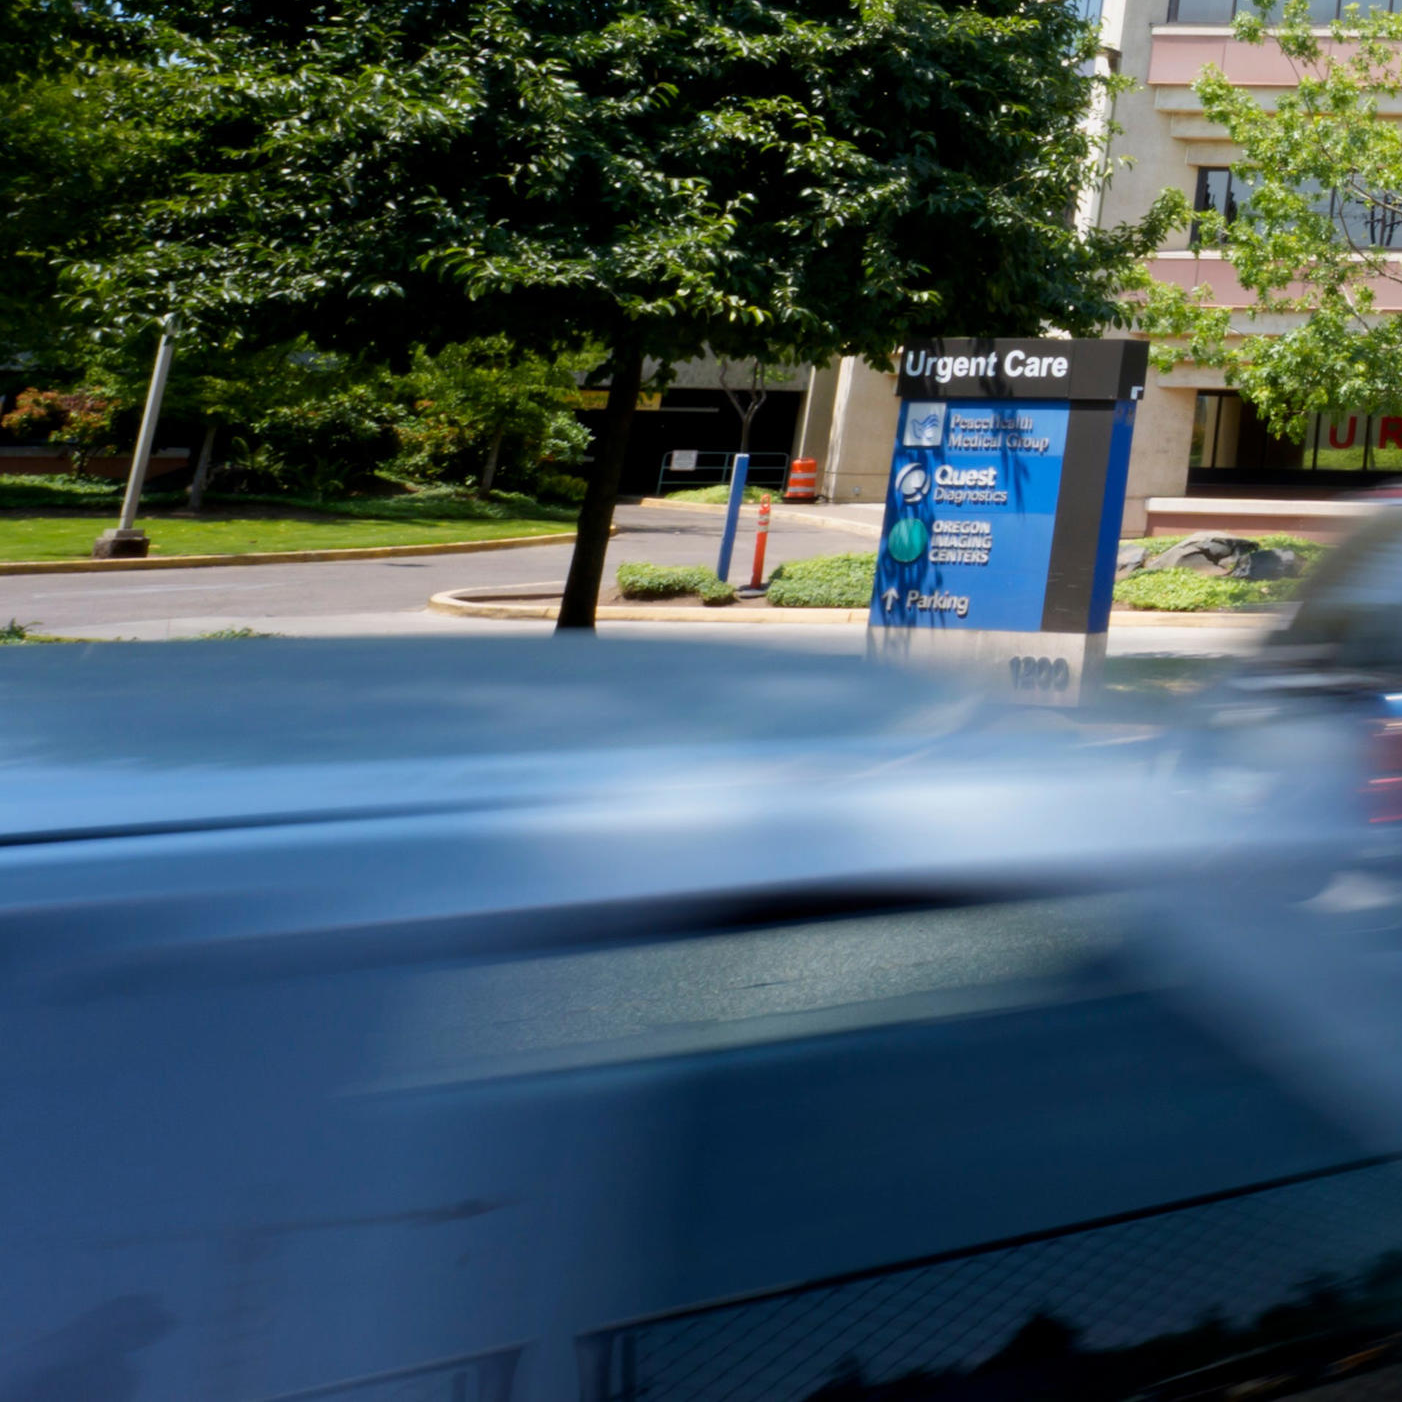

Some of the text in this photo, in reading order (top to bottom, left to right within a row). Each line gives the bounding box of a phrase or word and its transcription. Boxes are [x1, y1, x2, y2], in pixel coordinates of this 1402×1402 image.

[905, 349, 1068, 383] Urgent Care
[950, 412, 1034, 432] PeaceHealth
[947, 432, 1050, 454] Medical Group
[934, 464, 998, 487] Quest
[933, 486, 1008, 504] Diagnostics
[932, 519, 991, 534] OREGON
[930, 535, 993, 549] IMAGING
[928, 549, 989, 564] CENTERS
[906, 590, 970, 615] Parking
[1009, 655, 1070, 693] 1200
